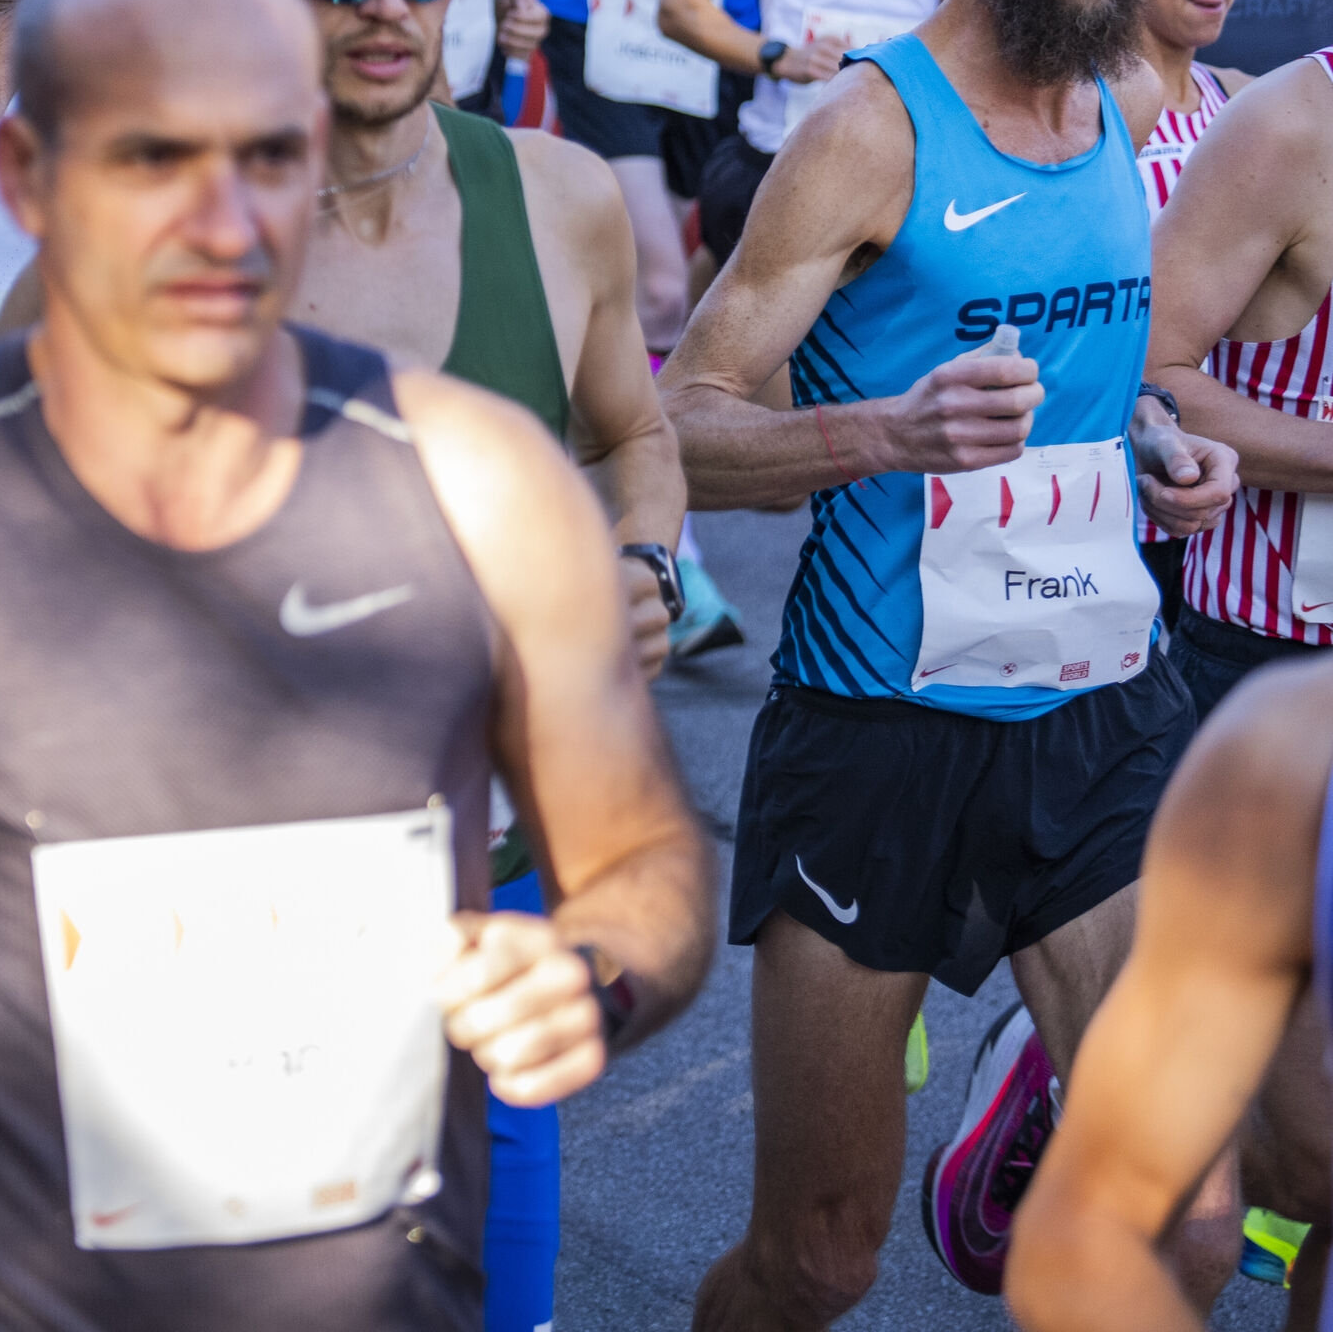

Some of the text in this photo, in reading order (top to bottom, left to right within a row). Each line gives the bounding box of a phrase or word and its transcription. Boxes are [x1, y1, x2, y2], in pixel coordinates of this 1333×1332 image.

[1004, 566, 1099, 601] Frank
[1062, 661, 1090, 673] SPORTS
[1060, 670, 1088, 681] WORLD
